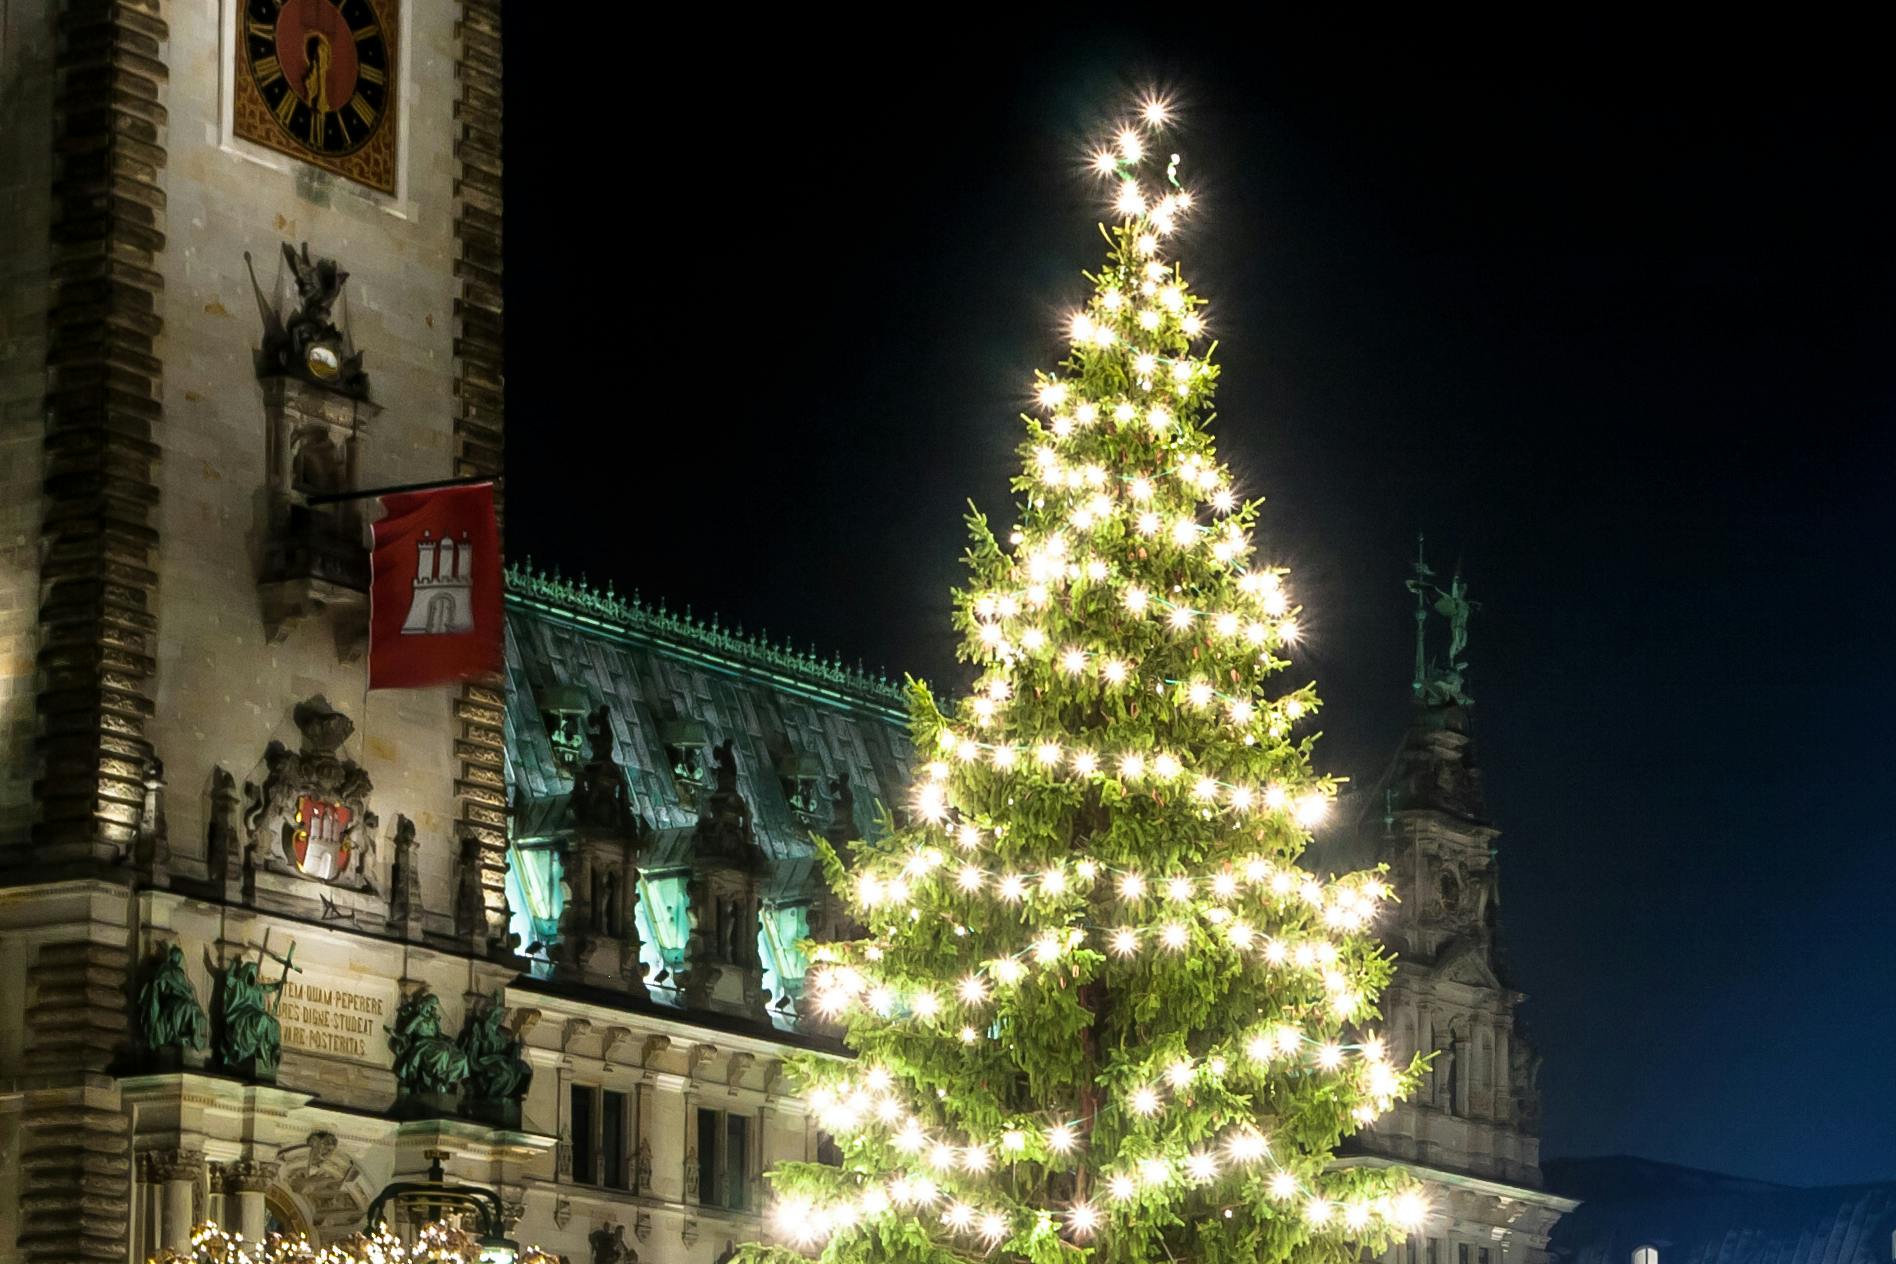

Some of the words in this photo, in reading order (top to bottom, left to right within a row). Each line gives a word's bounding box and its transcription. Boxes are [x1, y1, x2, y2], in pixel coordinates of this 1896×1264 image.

[335, 991, 383, 1016] PEPERERE
[303, 1006, 330, 1028] DIGNE
[333, 1013, 373, 1037] STUDEAT
[309, 1029, 366, 1057] POSTERITAS
